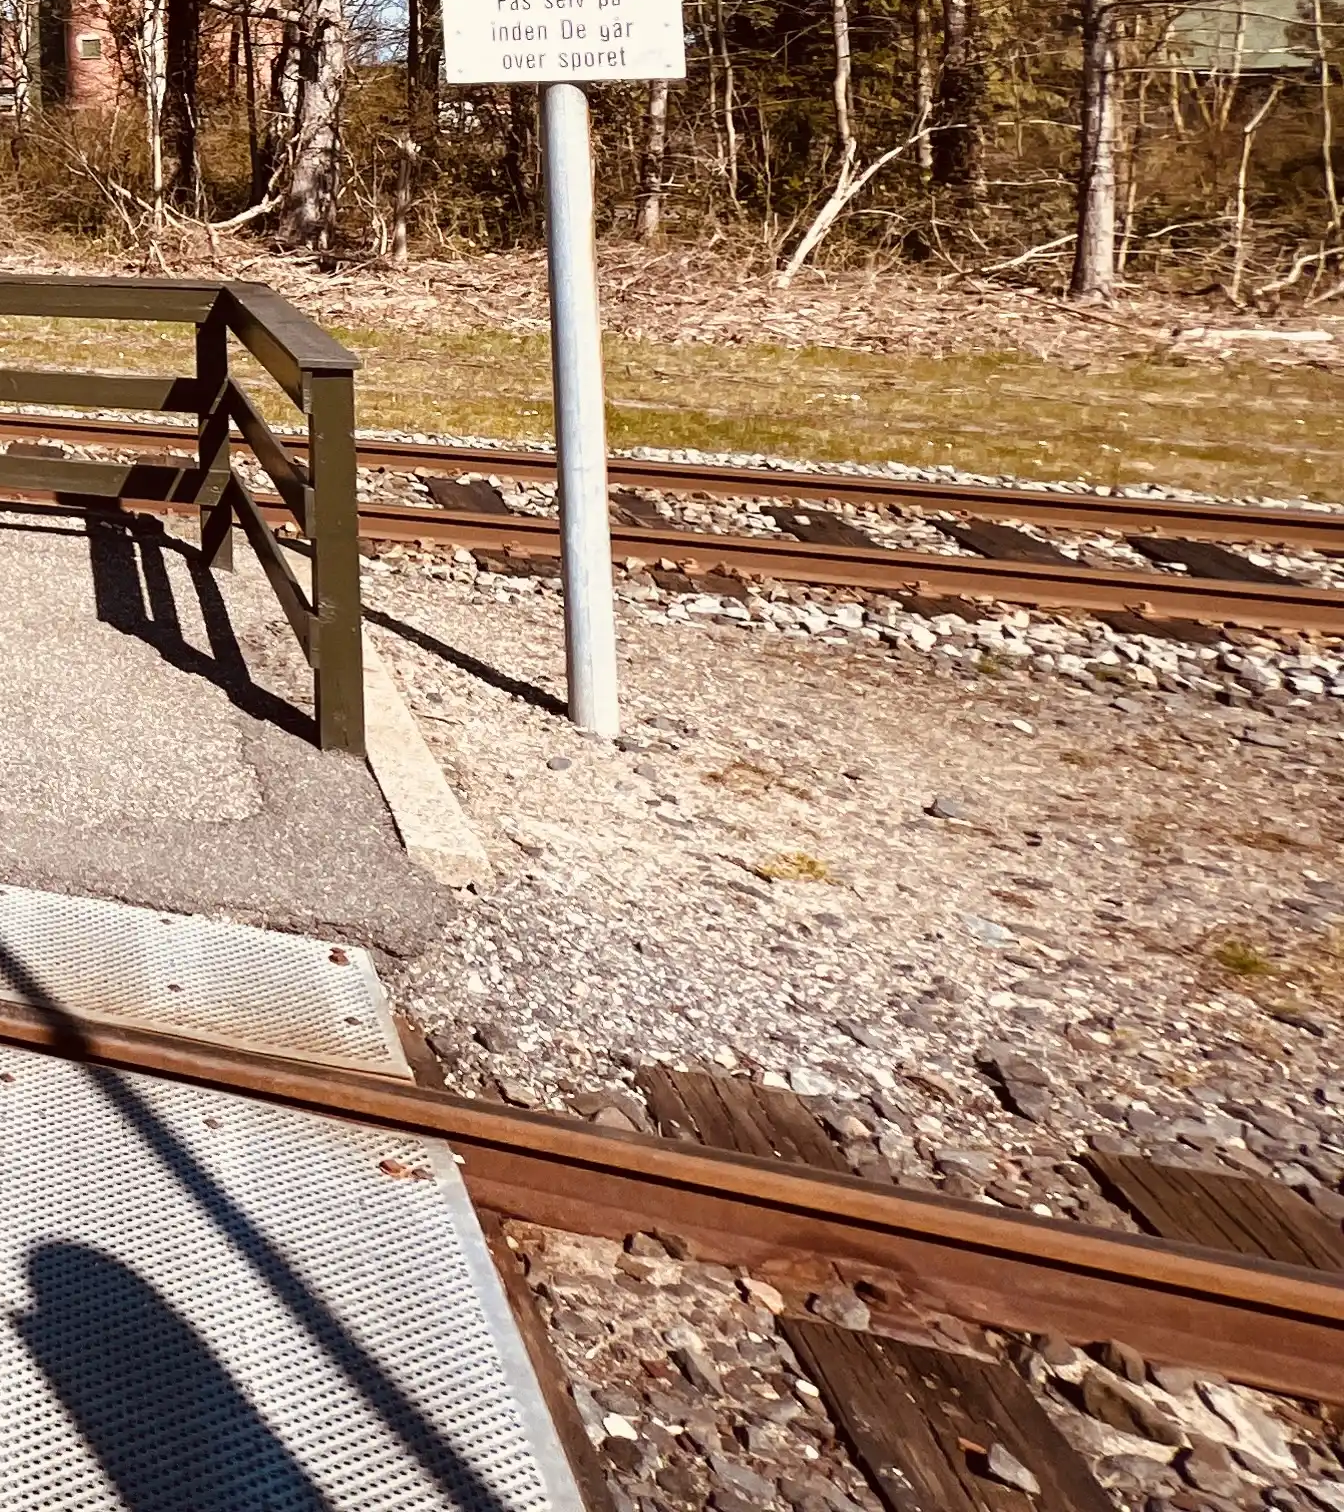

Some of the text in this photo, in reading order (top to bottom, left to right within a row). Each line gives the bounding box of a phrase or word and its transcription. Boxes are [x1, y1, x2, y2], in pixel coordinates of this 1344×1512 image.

[491, 17, 634, 42] inden De går
[503, 47, 627, 72] over sporet
